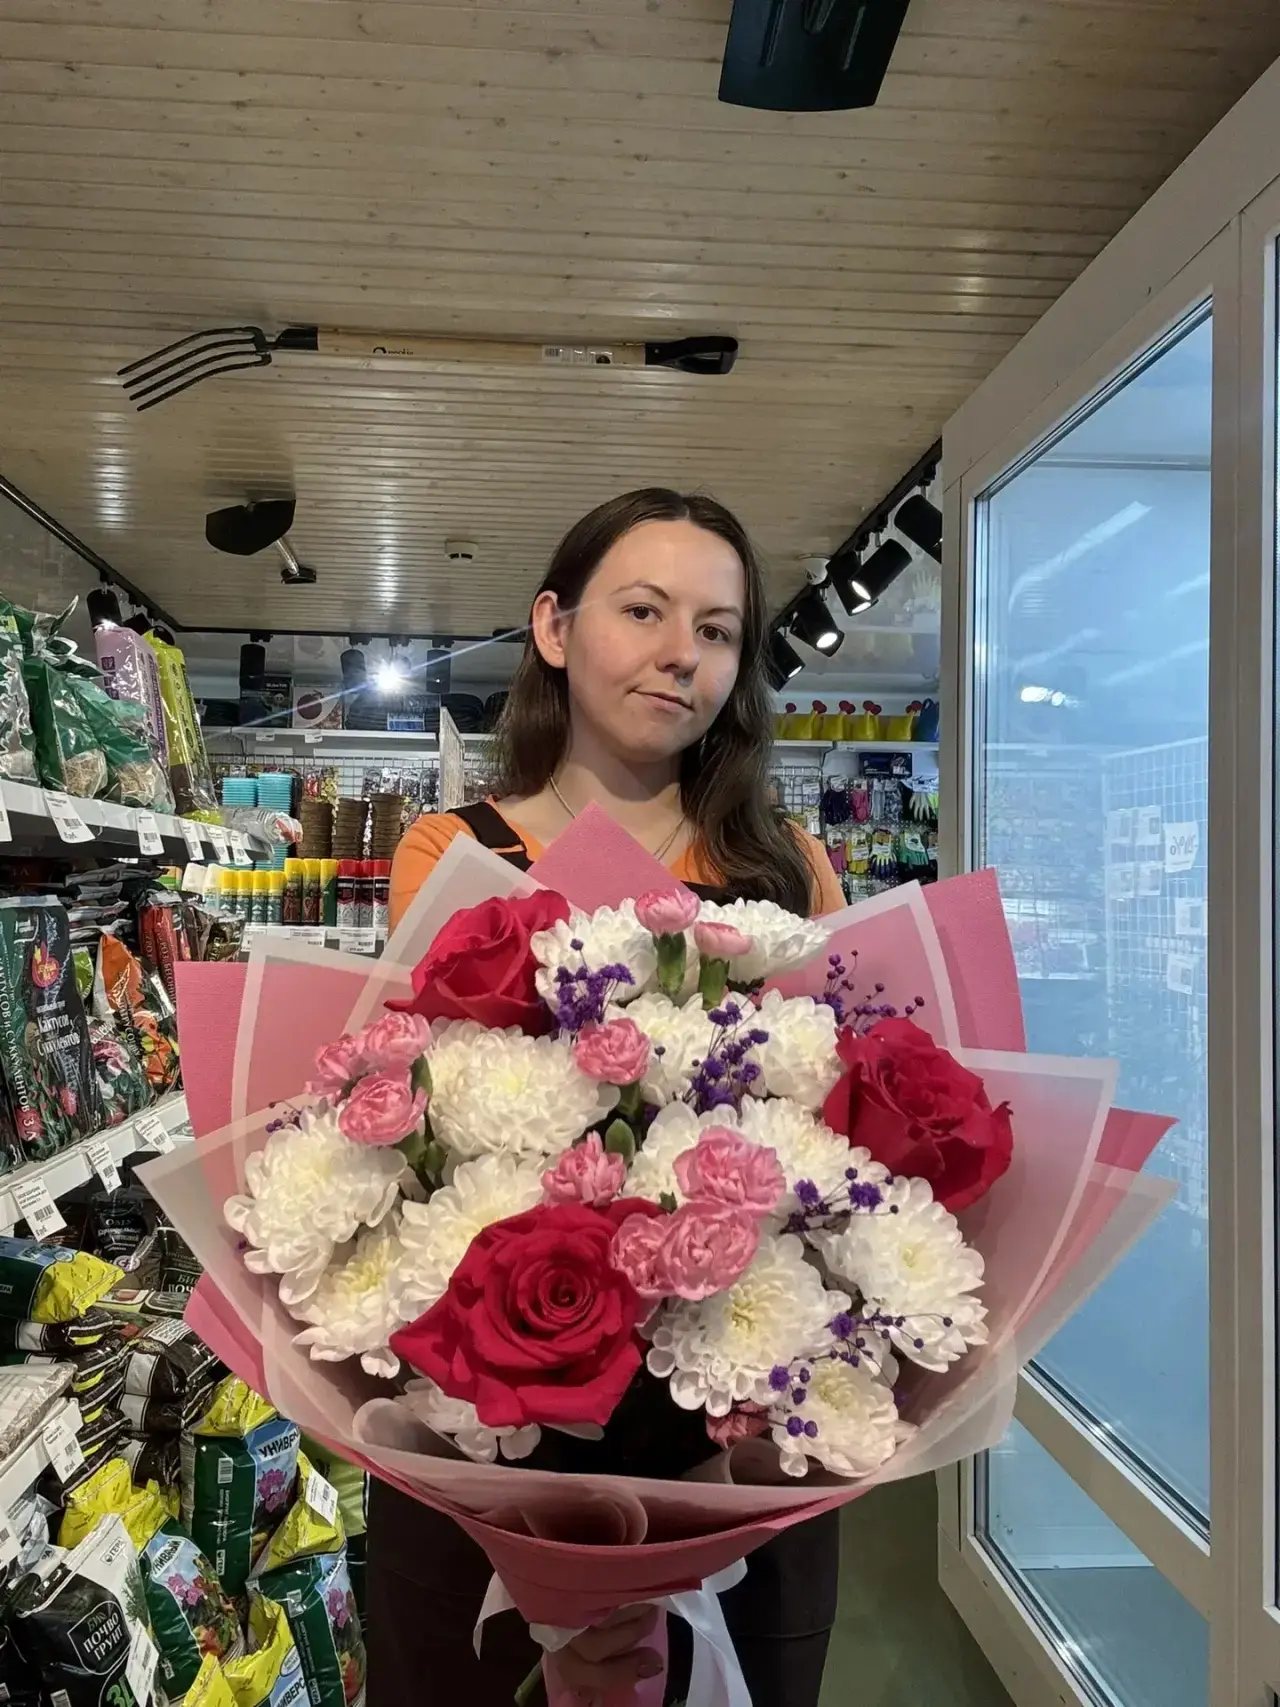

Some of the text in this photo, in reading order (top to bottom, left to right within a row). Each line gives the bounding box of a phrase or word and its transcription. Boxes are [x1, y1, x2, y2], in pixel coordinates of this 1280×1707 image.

[5, 1030, 31, 1112] СУККУЛЕНТОВ
[23, 1117, 35, 1128] 3
[83, 1612, 119, 1653] ПОЧВО
[94, 1626, 124, 1661] ГРУНТ
